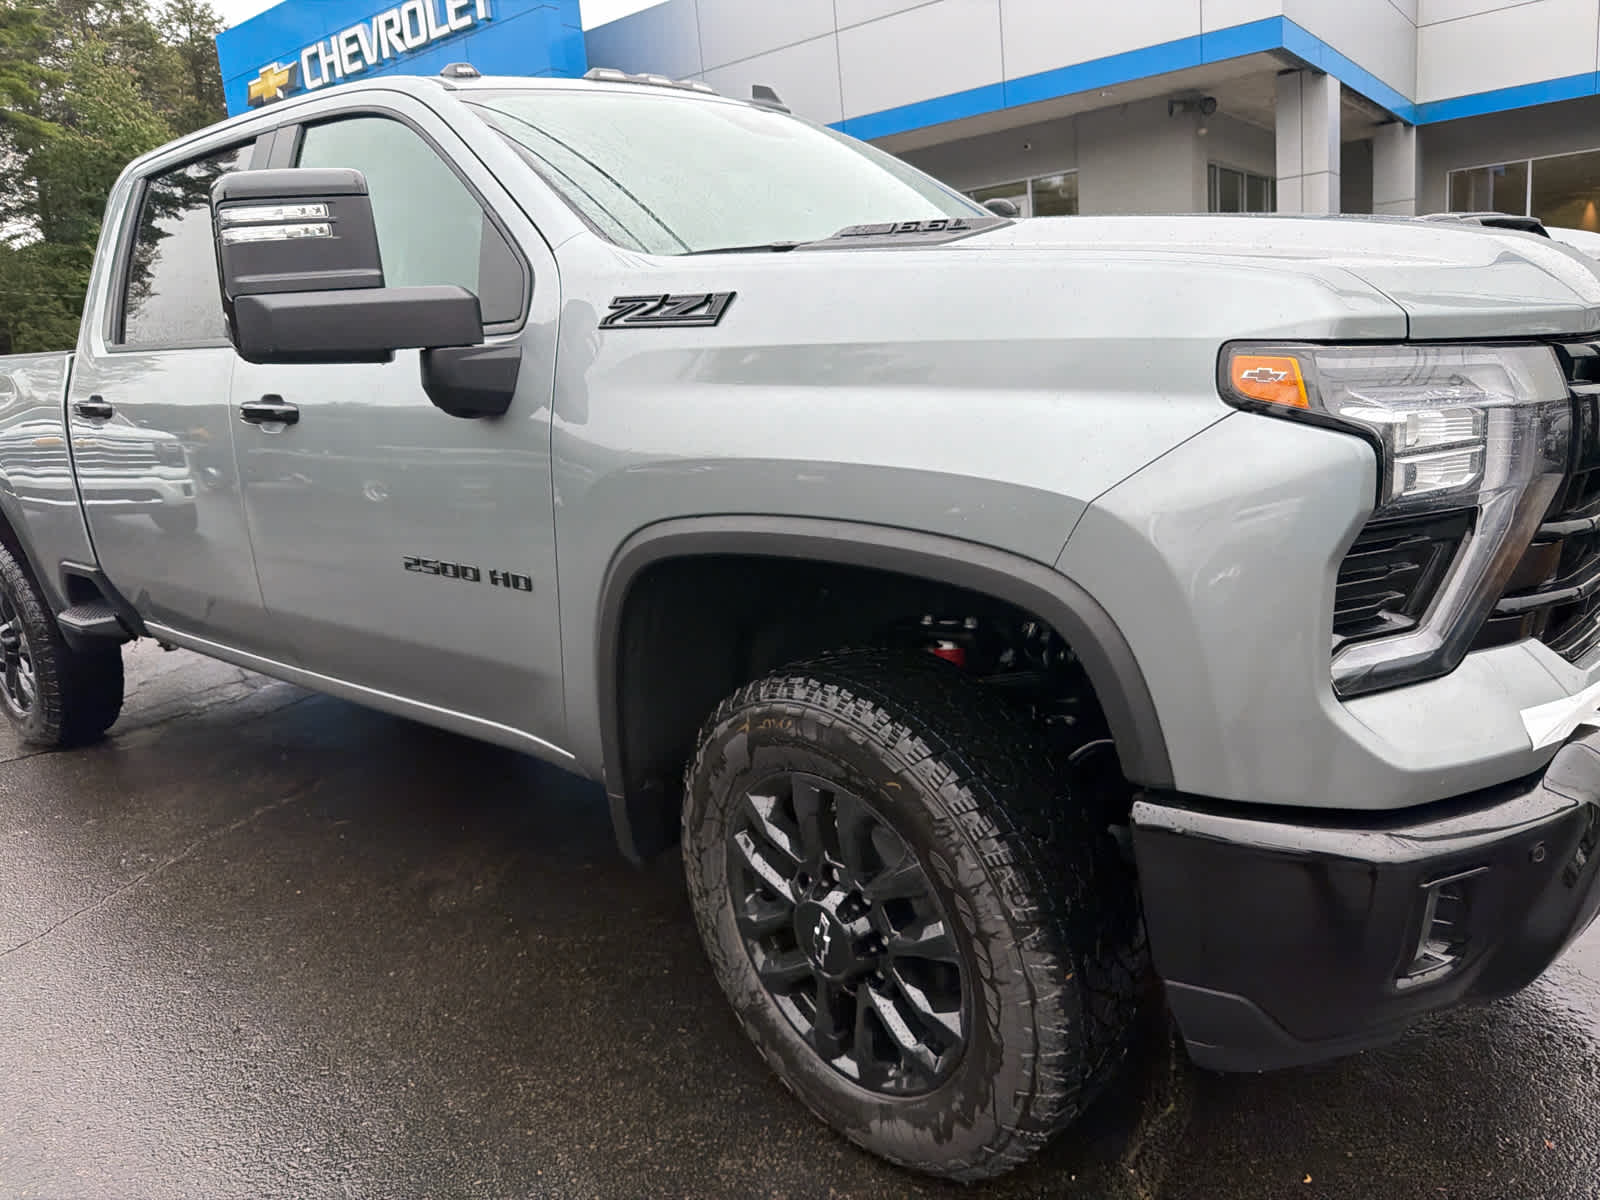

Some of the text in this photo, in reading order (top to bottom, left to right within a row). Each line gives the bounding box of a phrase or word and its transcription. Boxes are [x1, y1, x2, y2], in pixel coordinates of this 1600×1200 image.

[598, 291, 737, 329] Z71
[403, 554, 533, 592] 2500 HD
